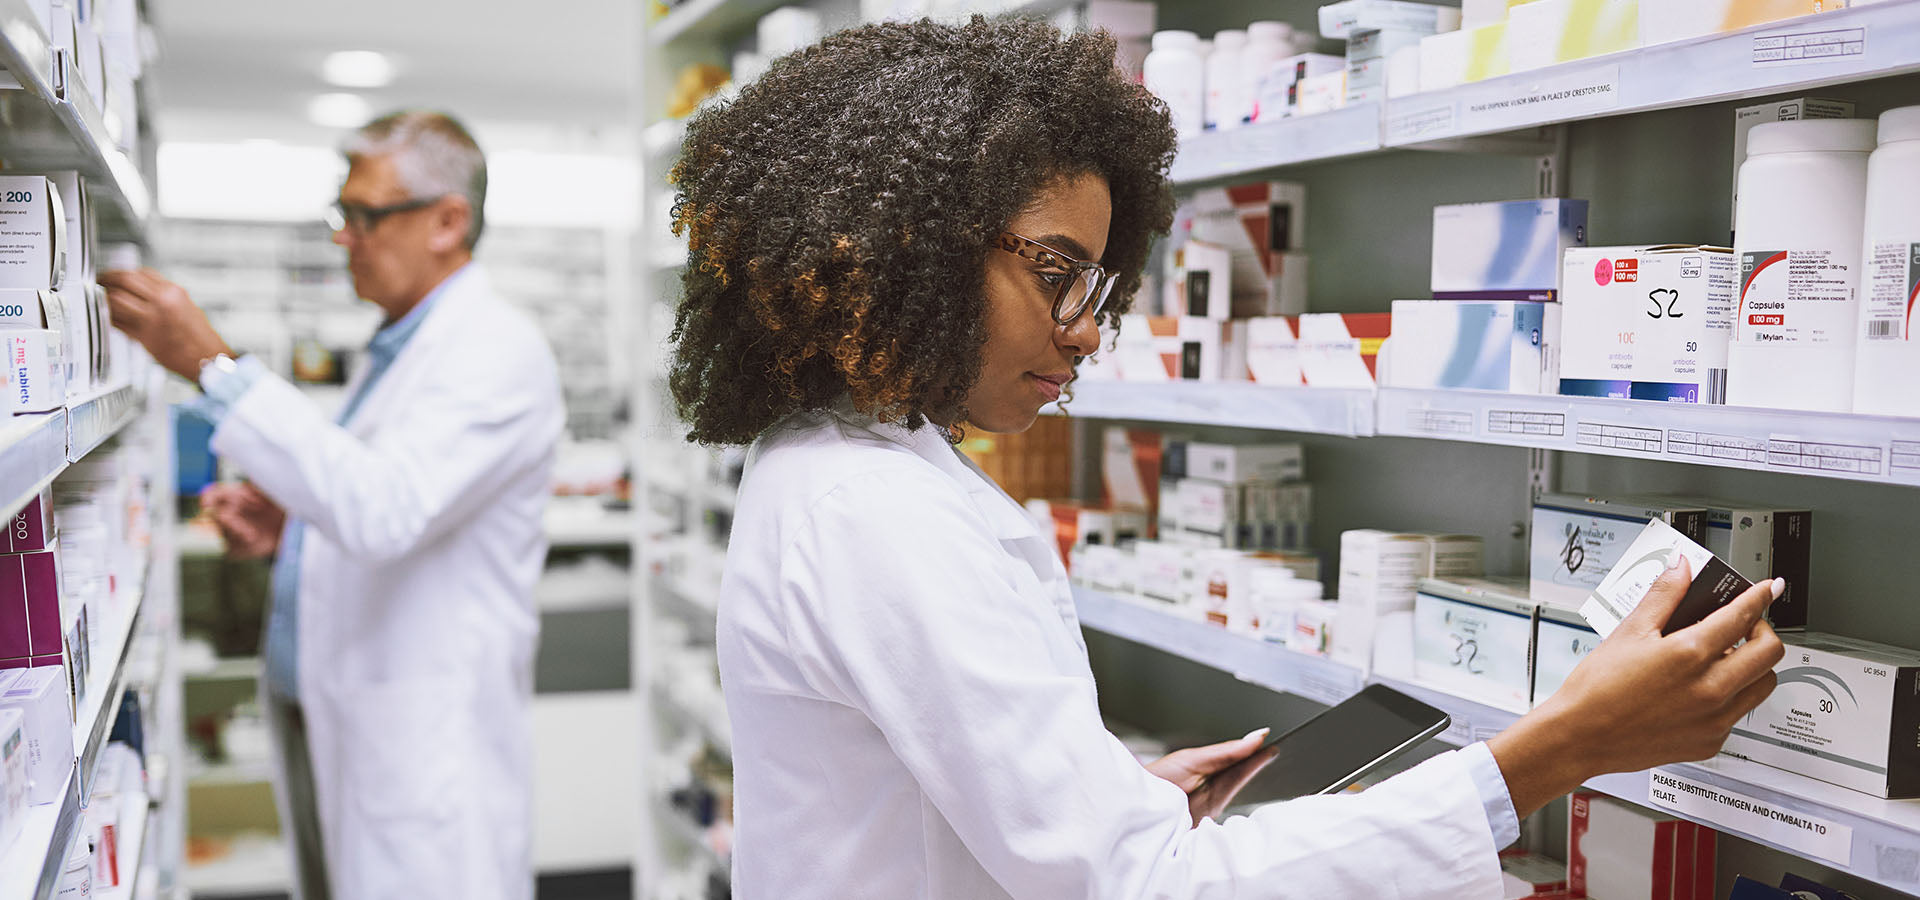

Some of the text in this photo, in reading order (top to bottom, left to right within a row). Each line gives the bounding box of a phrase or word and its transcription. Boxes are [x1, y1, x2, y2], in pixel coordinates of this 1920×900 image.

[1547, 92, 1563, 101] PLACE
[1564, 90, 1571, 98] OF
[1572, 86, 1596, 97] CRESTOR
[6, 191, 32, 203] 200
[1615, 272, 1626, 281] 100
[1627, 273, 1637, 282] mg
[0, 304, 23, 317] 200
[1748, 301, 1785, 310] Capsules
[1766, 317, 1780, 325] mg
[1762, 334, 1784, 342] Mylan
[1685, 341, 1697, 352] 50
[16, 348, 26, 364] mg
[19, 367, 30, 404] tablets
[15, 513, 28, 540] 200
[1863, 666, 1887, 677] UC 9543
[1819, 699, 1833, 714] 30
[1791, 708, 1812, 719] Kapsules
[1652, 788, 1678, 804] YELATE.
[1653, 774, 1827, 835] PLEASE SUBSTITUTE CYMGEN AND CYMBALTA TO
